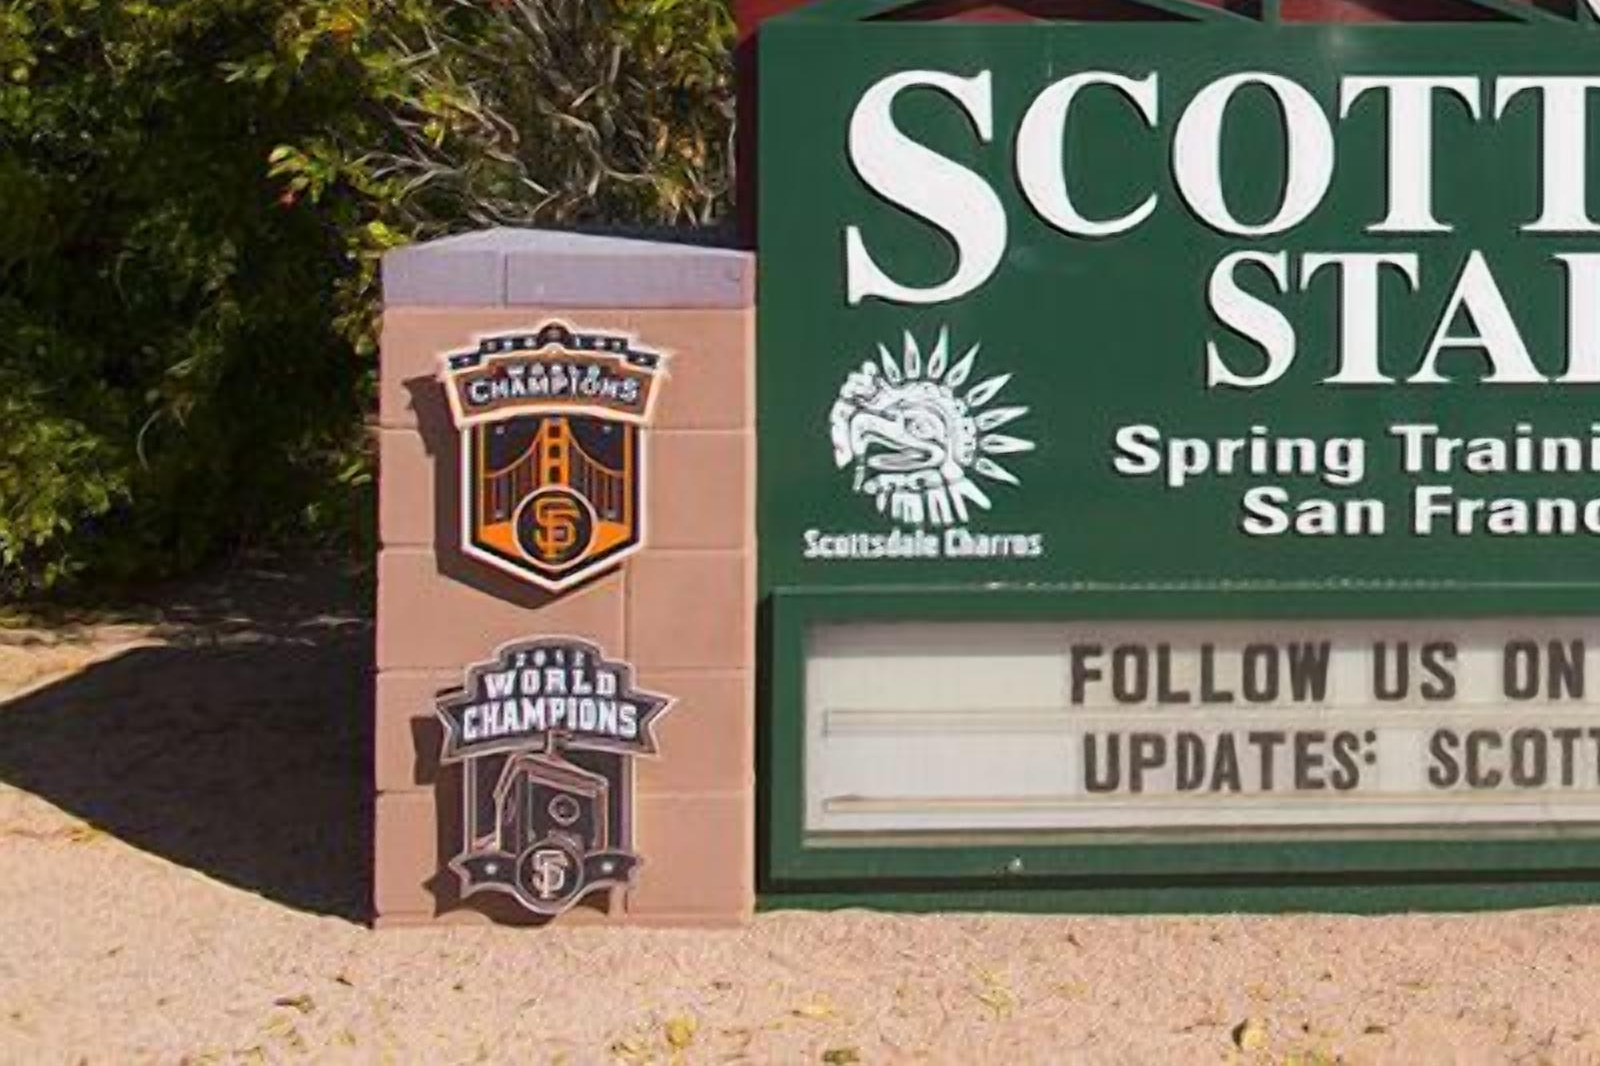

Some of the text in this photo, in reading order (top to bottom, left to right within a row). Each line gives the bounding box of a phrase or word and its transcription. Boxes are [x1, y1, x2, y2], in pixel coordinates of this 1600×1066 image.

[469, 376, 640, 402] CHAMPIONS
[1114, 424, 1365, 488] Spring
[1243, 486, 1386, 535] San
[804, 528, 1042, 558] Scottsdale Charros
[484, 669, 617, 698] WORLD
[1070, 642, 1333, 704] FOLLOW
[1372, 640, 1459, 702] US
[1502, 640, 1586, 701] ON
[463, 696, 637, 741] CHAMPIONS
[1083, 730, 1377, 793] UPDATES:
